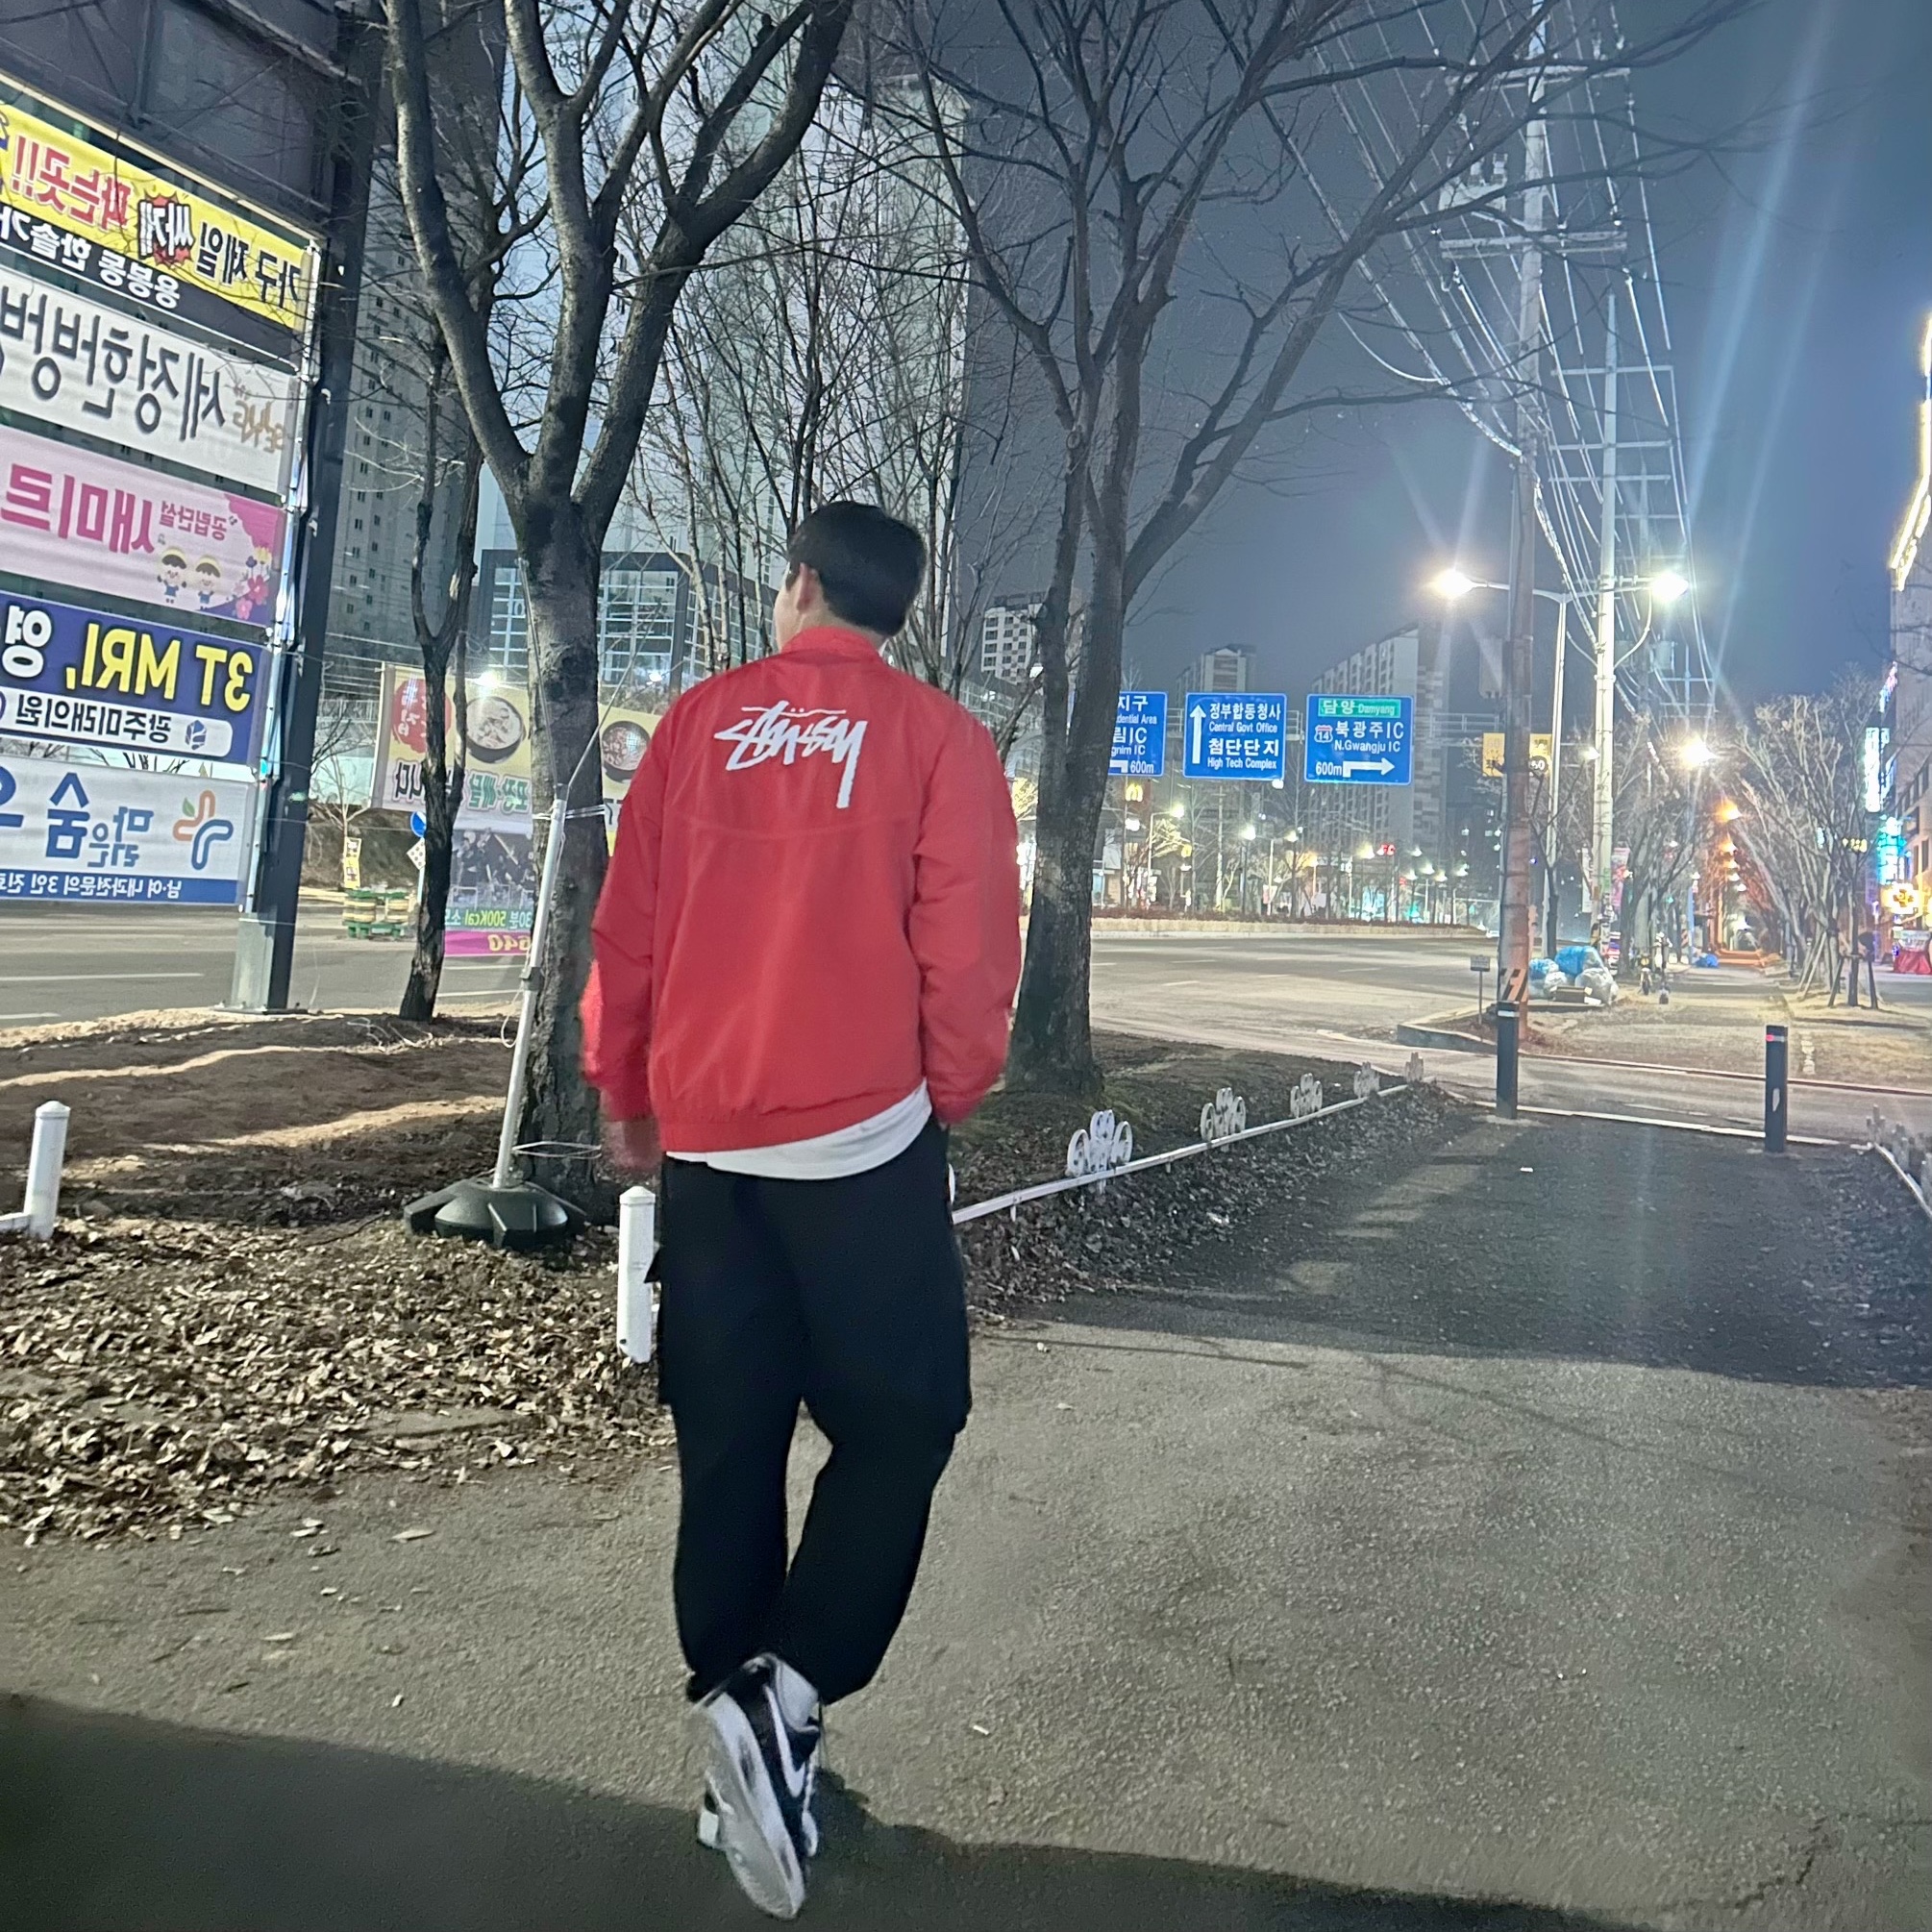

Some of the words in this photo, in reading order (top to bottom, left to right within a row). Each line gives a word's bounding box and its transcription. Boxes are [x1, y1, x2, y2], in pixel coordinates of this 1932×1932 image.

[1118, 694, 1149, 712] 지구
[1323, 700, 1355, 715] 담양
[1357, 705, 1396, 716] Damyang
[1209, 702, 1281, 721] 정부합동청사
[1116, 714, 1139, 724] dential
[1140, 714, 1157, 725] Area
[1208, 722, 1234, 732] Central
[1236, 722, 1253, 733] Govt
[1255, 722, 1278, 733] Office
[1113, 727, 1148, 744] 림IC
[1318, 731, 1329, 740] 14
[1110, 745, 1132, 757] gnim
[1134, 745, 1146, 755] IC
[1208, 738, 1279, 757] 첨단단지
[1388, 741, 1401, 753] IC
[1130, 760, 1154, 774] 600m
[1207, 757, 1223, 770] High
[1225, 757, 1243, 769] Tech
[1245, 757, 1277, 771] Complex
[1315, 761, 1343, 777] 600m
